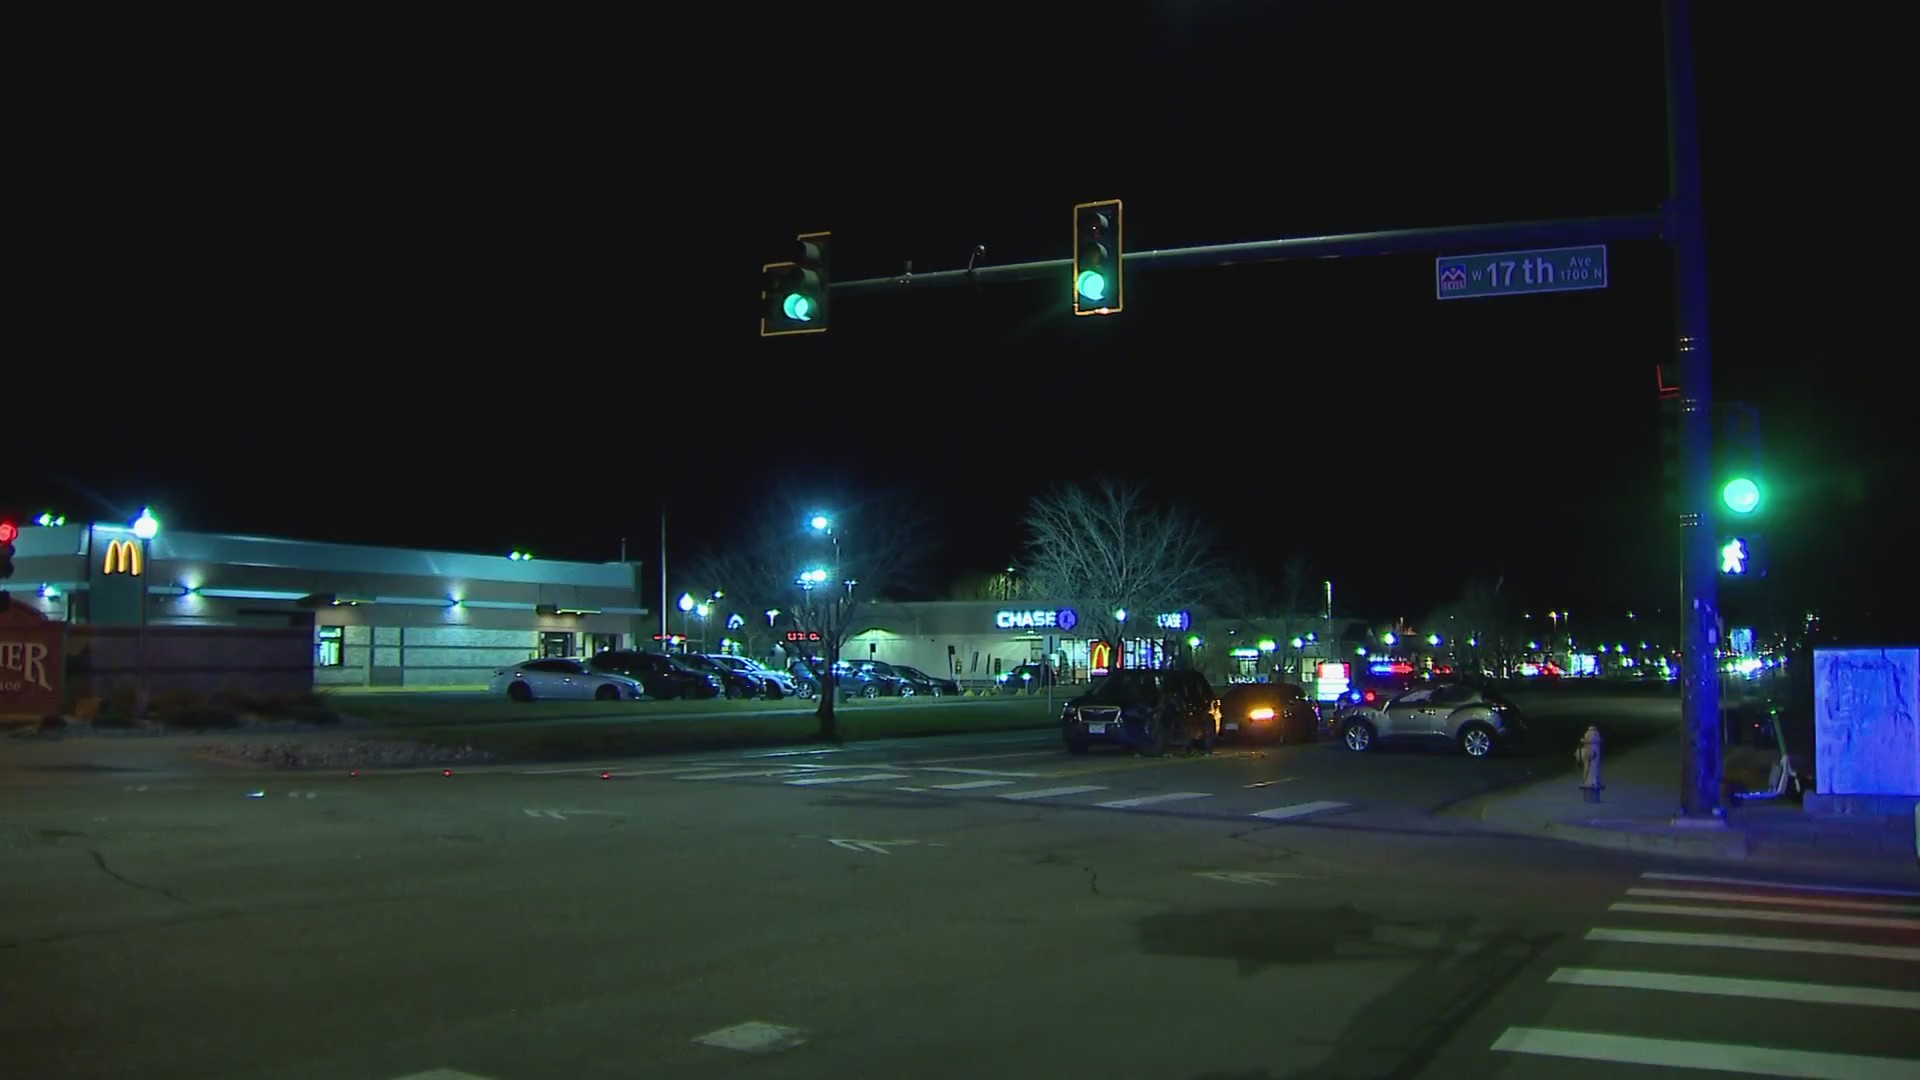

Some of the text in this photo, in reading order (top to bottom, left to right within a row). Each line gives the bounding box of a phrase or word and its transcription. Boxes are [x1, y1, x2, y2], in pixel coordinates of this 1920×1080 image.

[1569, 256, 1592, 268] Ave
[1472, 270, 1483, 281] W
[1487, 257, 1554, 287] 17th
[1561, 267, 1602, 282] 1700 N
[997, 610, 1056, 628] CHASE
